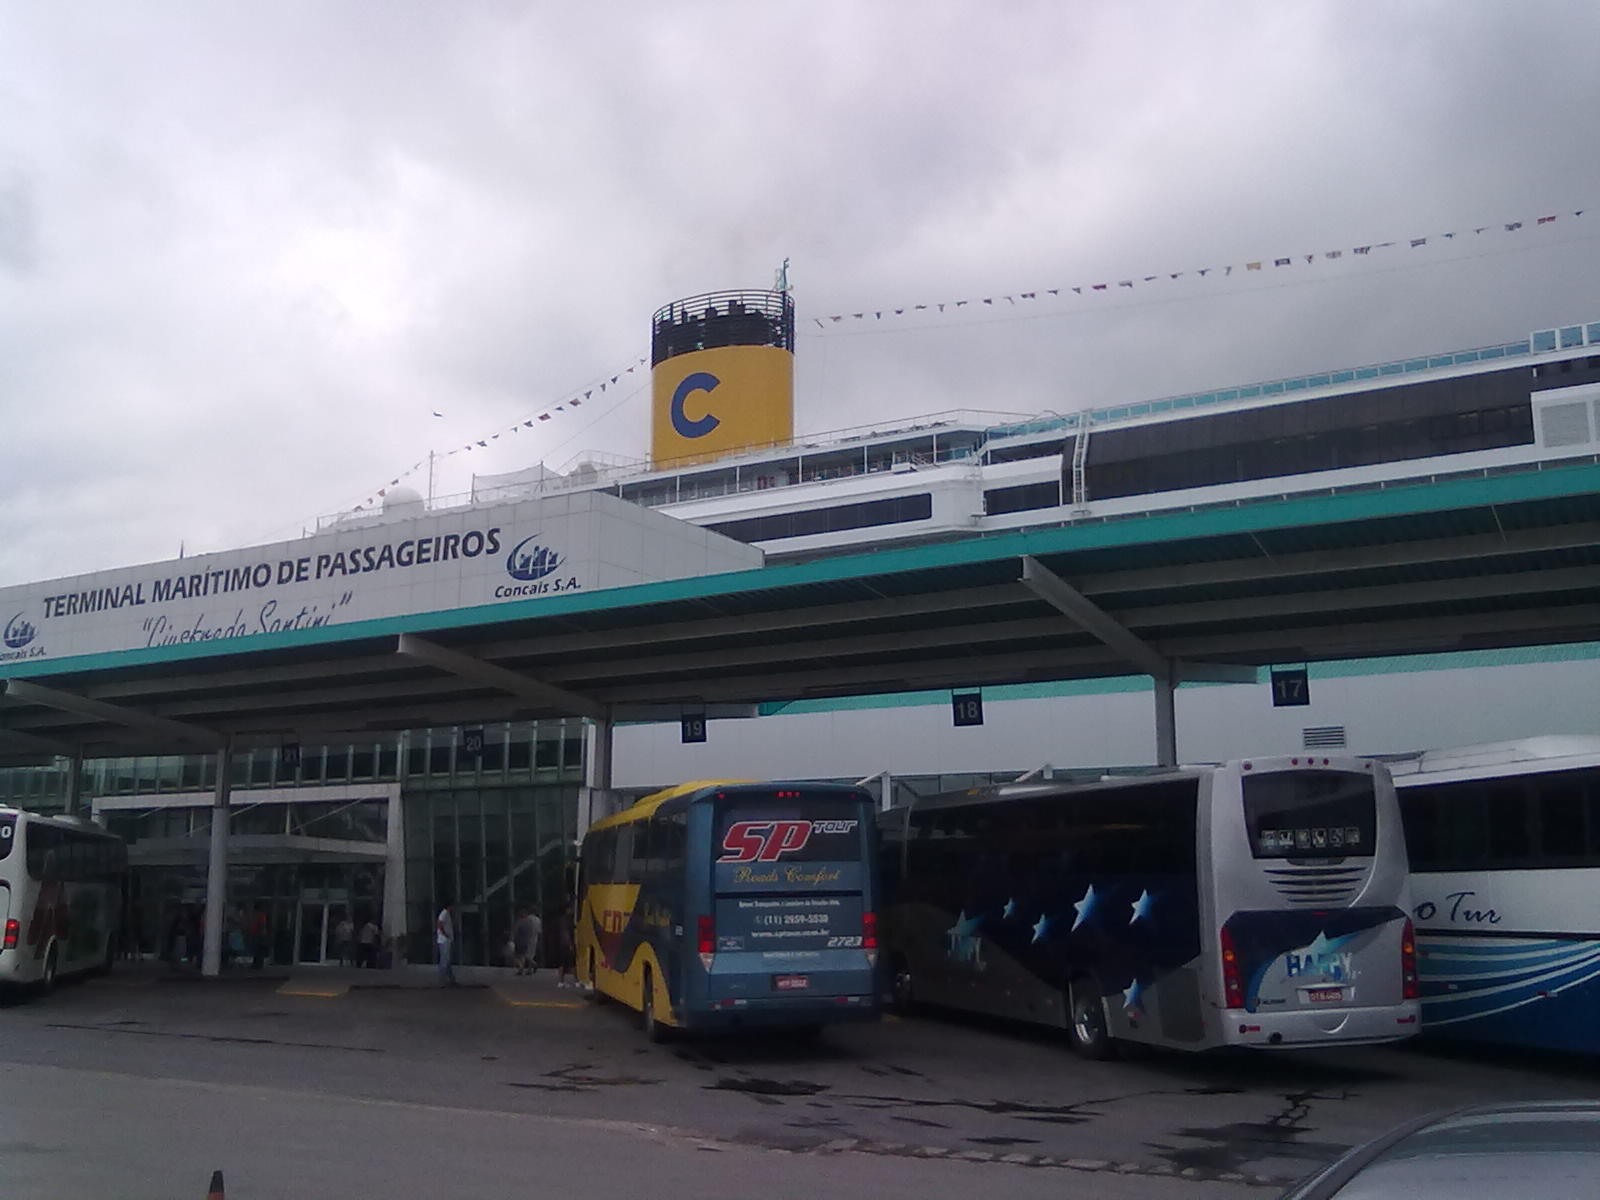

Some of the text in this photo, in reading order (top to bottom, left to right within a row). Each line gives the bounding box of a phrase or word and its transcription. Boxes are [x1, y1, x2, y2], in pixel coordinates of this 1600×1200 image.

[670, 371, 720, 438] C
[43, 527, 501, 619] TERMINAL MARÍTIMO DE PASSAGEIROS
[494, 576, 582, 599] Concais S.A.
[1276, 679, 1302, 698] 17
[957, 701, 978, 719] 18
[684, 720, 703, 737] 19
[466, 735, 482, 752] 20
[715, 820, 813, 864] SP
[1445, 891, 1502, 924] Tur
[827, 935, 863, 948] 2723
